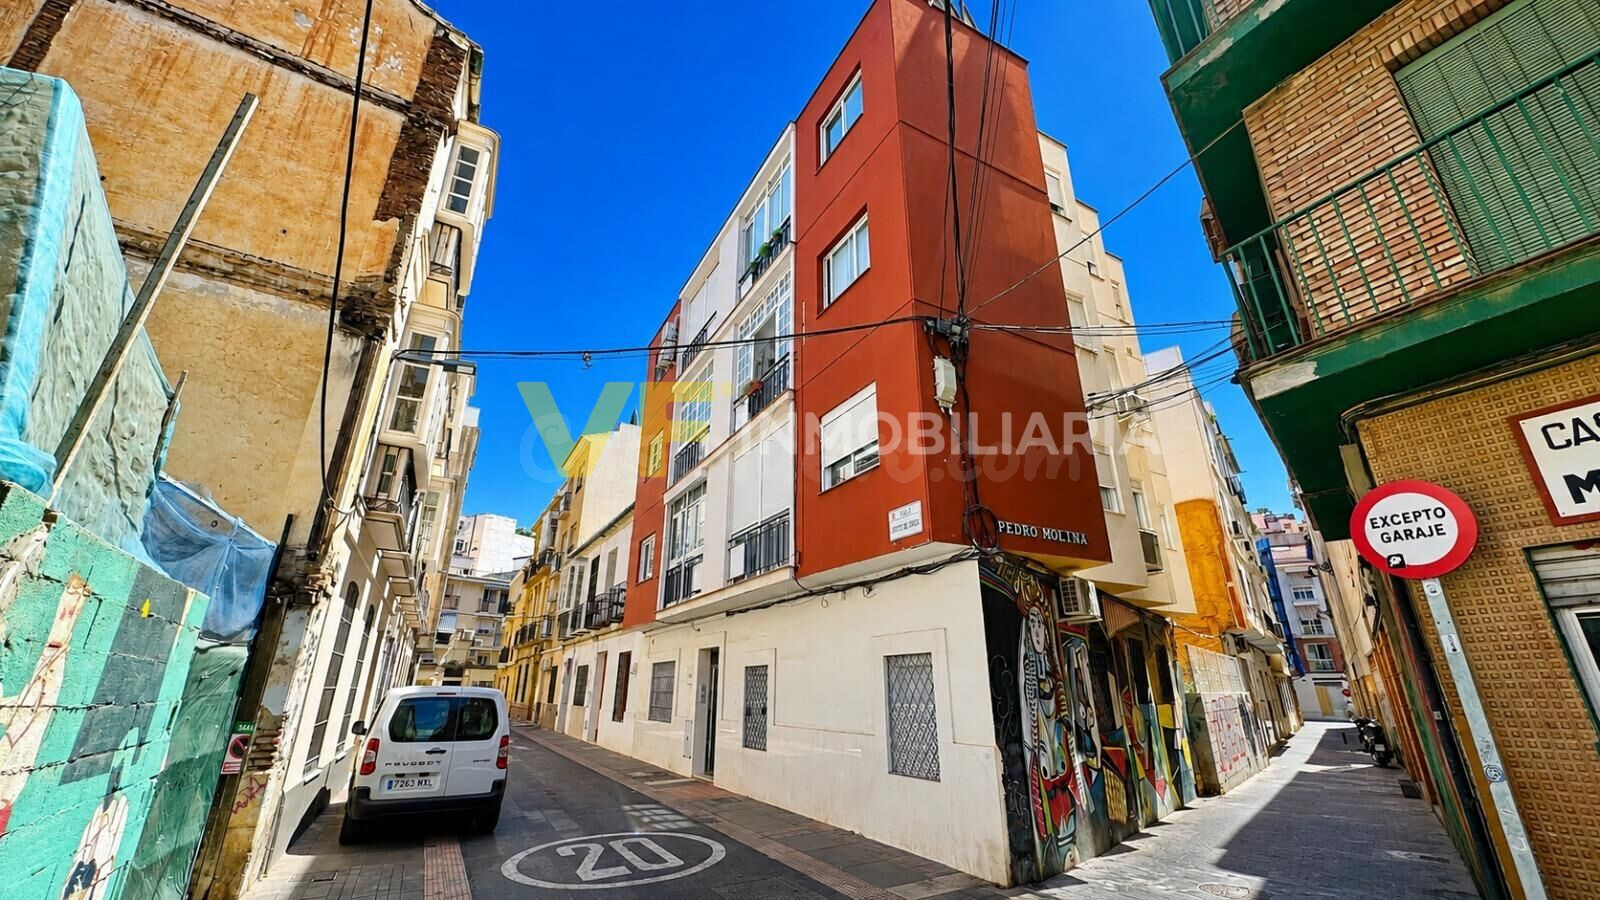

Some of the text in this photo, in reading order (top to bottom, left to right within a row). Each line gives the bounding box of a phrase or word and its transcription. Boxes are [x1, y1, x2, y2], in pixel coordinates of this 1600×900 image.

[1541, 411, 1600, 450] CA
[1369, 506, 1447, 530] EXCEPTO
[997, 520, 1088, 545] PEDRO MOLINA
[1380, 523, 1447, 544] GARAJE
[555, 837, 685, 882] 20
